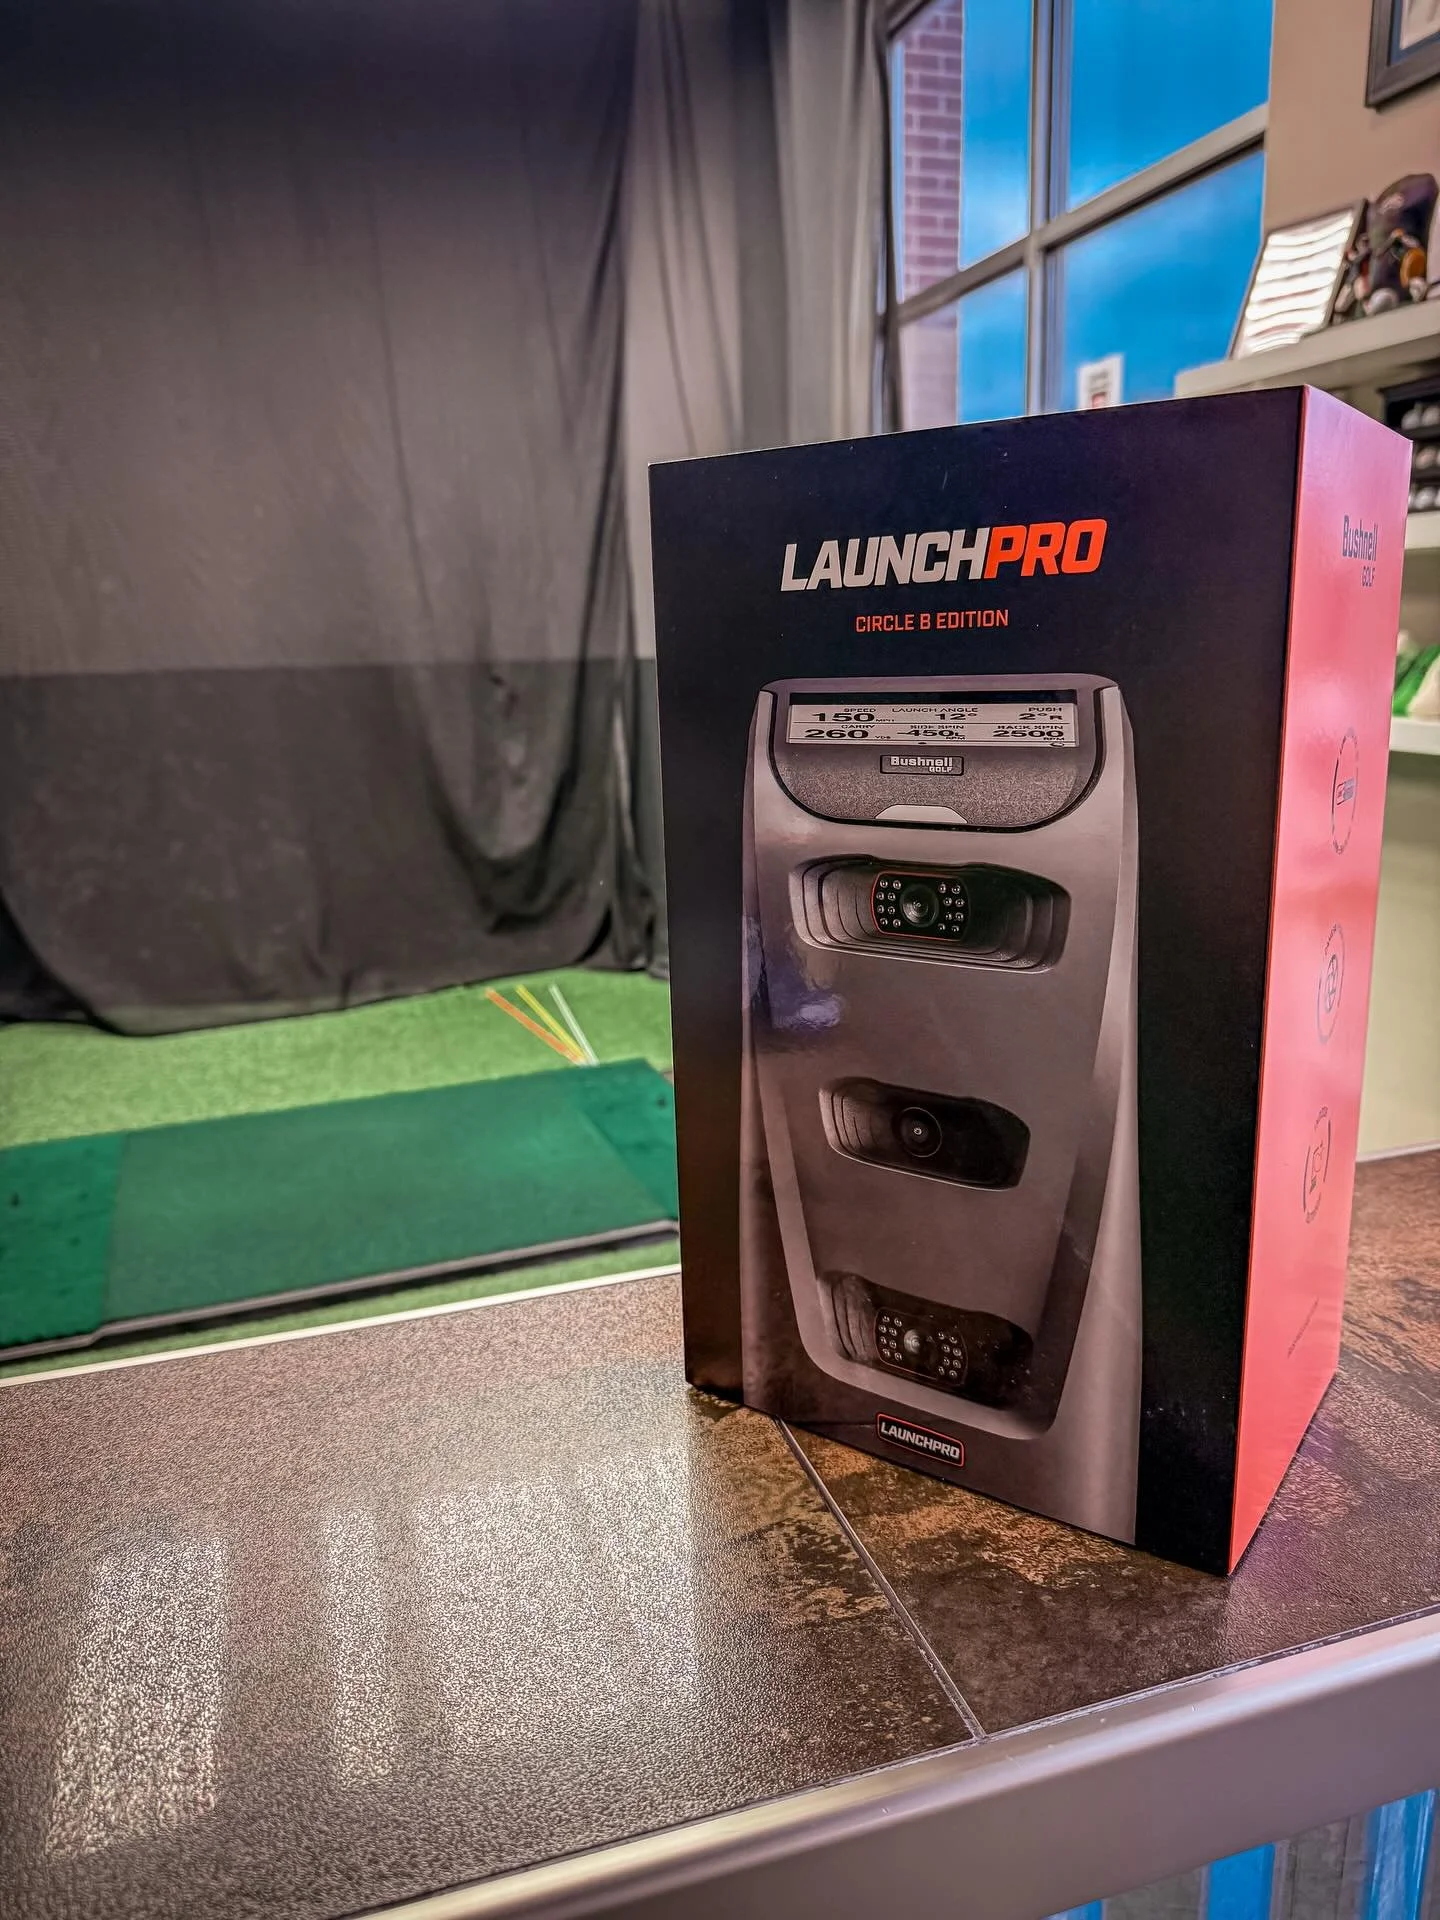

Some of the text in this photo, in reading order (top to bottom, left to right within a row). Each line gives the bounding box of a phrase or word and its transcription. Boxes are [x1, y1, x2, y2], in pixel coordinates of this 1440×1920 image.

[1342, 515, 1378, 562] Bushnell
[781, 518, 1108, 592] LAUNCHPRO
[1361, 566, 1376, 587] GOLF
[855, 609, 1009, 634] CIRCLE B EDITION
[812, 712, 875, 722] 150
[804, 729, 869, 739] 260
[992, 729, 1064, 738] 2500
[890, 756, 953, 767] Bushnell
[880, 1422, 960, 1458] LAUNCHPRO
